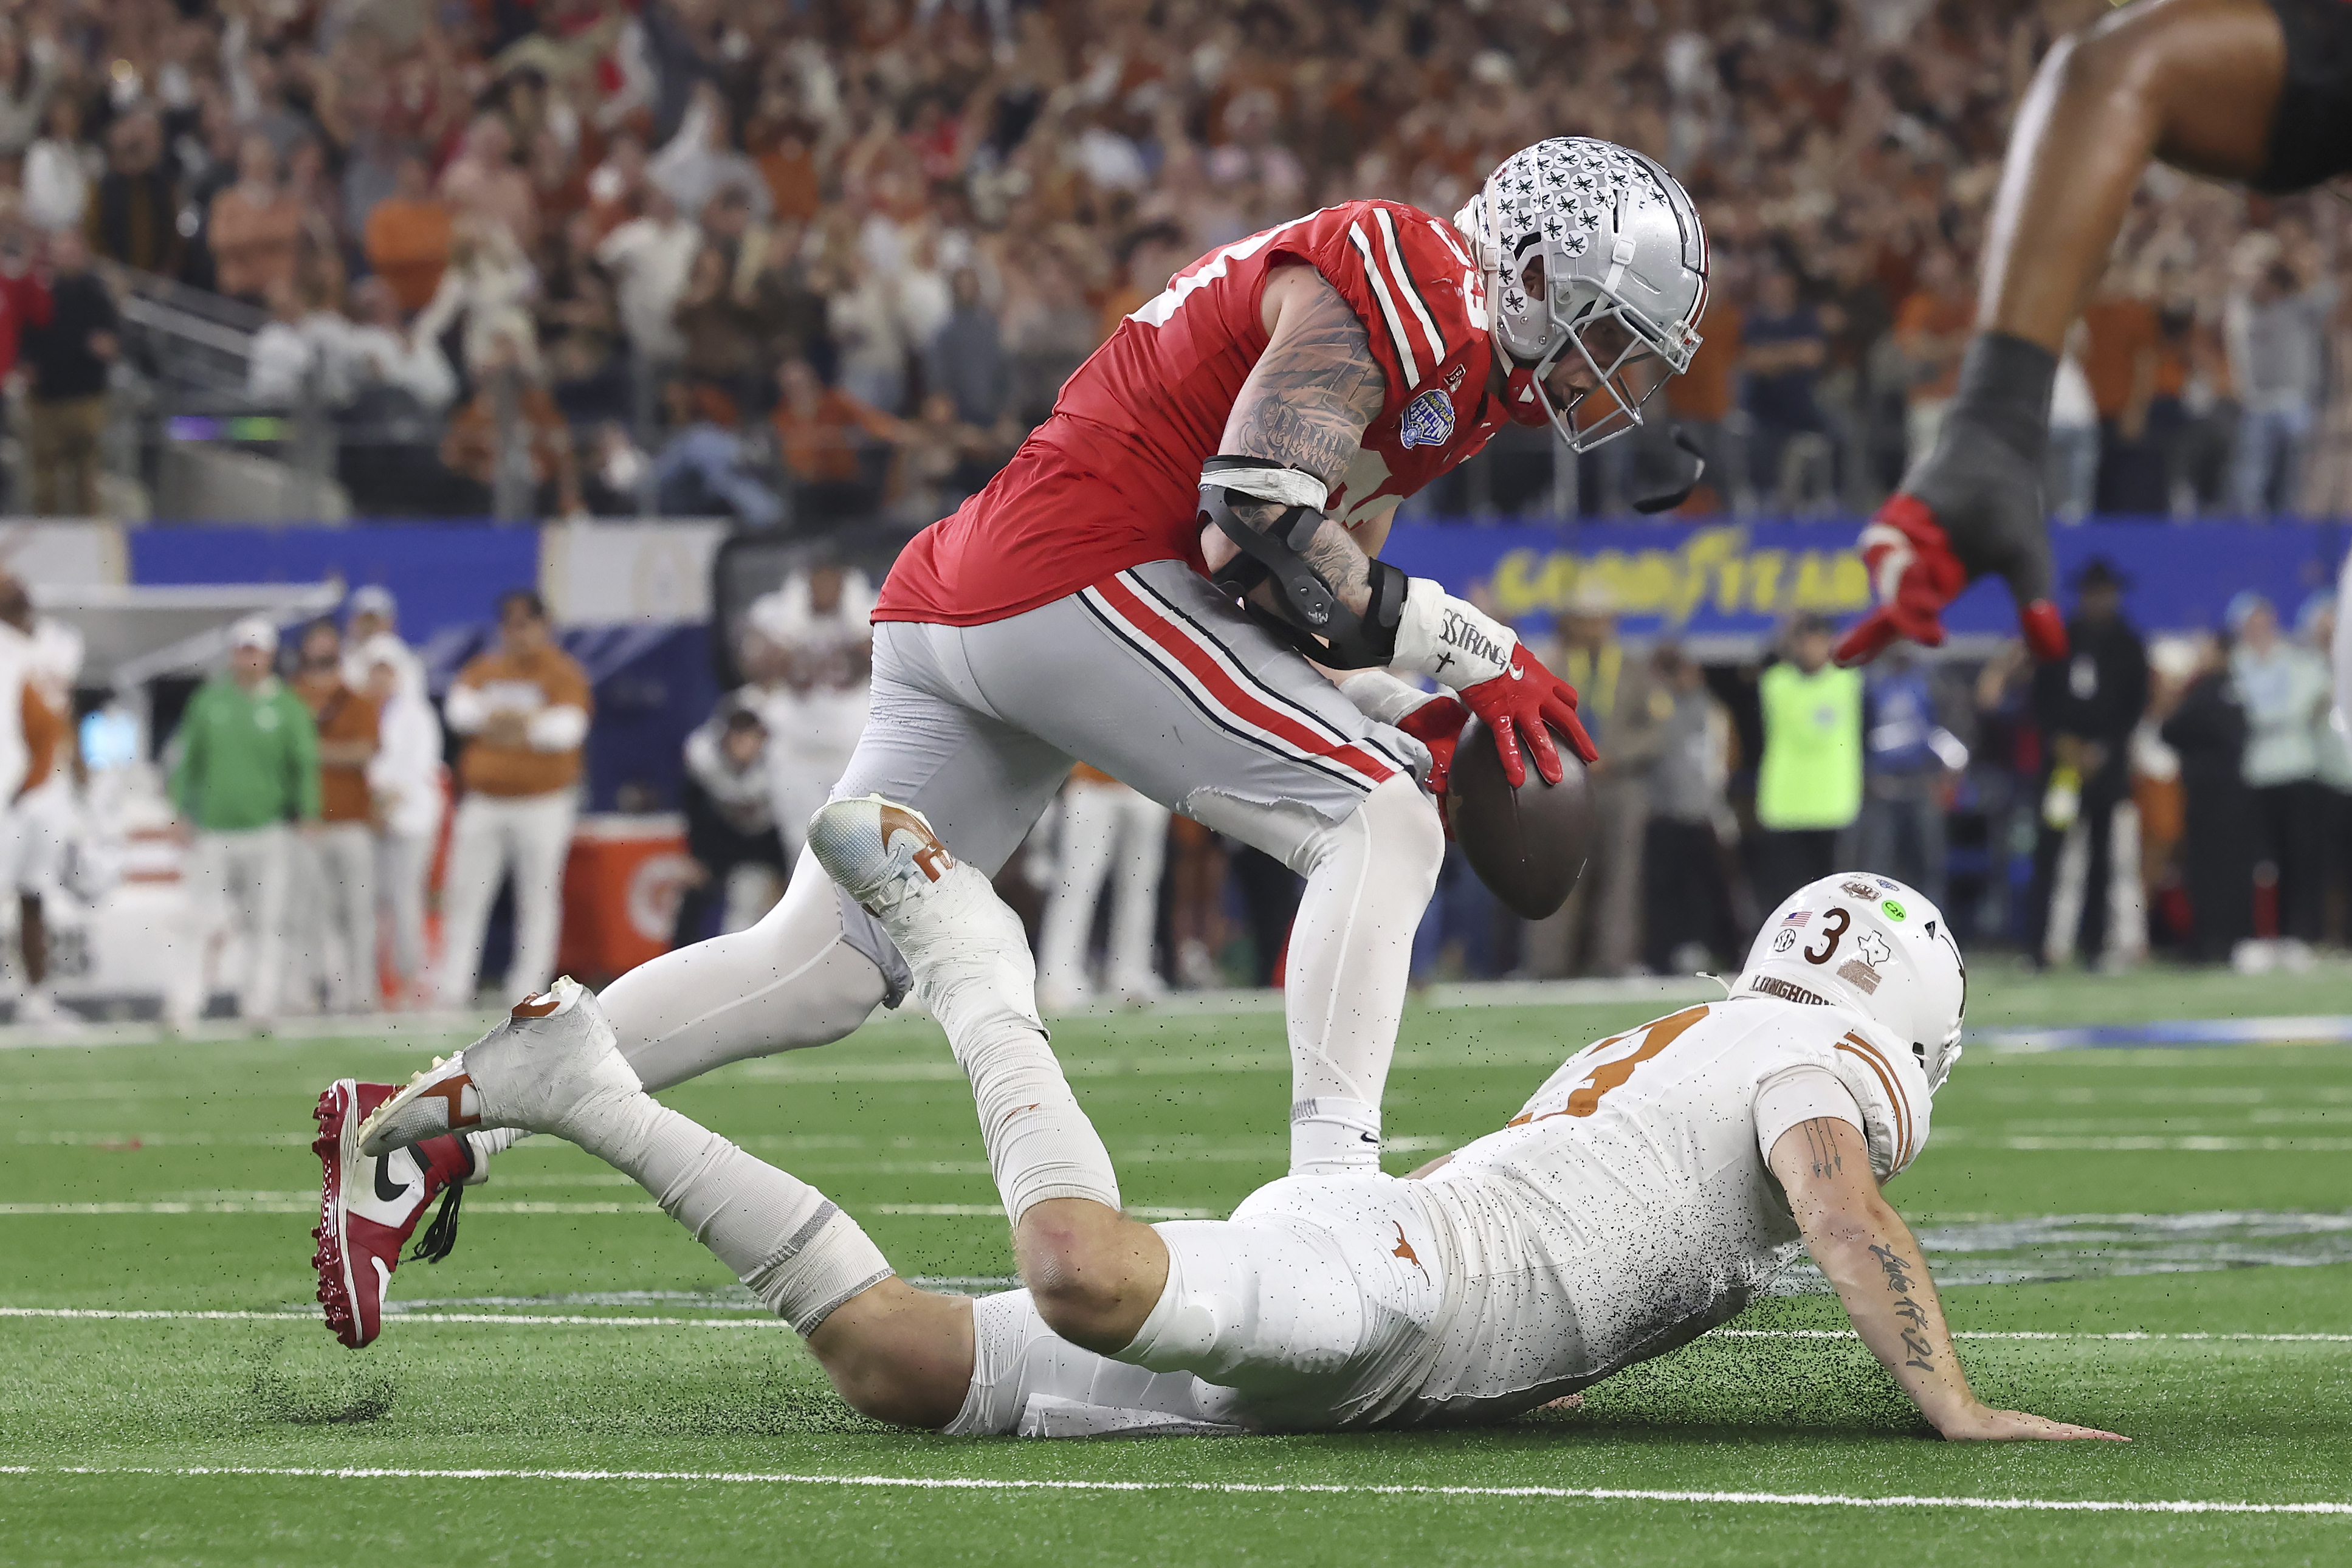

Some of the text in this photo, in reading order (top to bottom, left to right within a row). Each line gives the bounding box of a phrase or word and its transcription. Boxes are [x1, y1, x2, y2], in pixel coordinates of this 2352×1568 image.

[1411, 397, 1449, 439] COTTON
[1411, 411, 1434, 436] BOWL
[1885, 902, 1904, 918] C2P
[1774, 929, 1796, 952] SEC
[1804, 907, 1851, 965] 3
[1748, 974, 1838, 1007] LONGHOR
